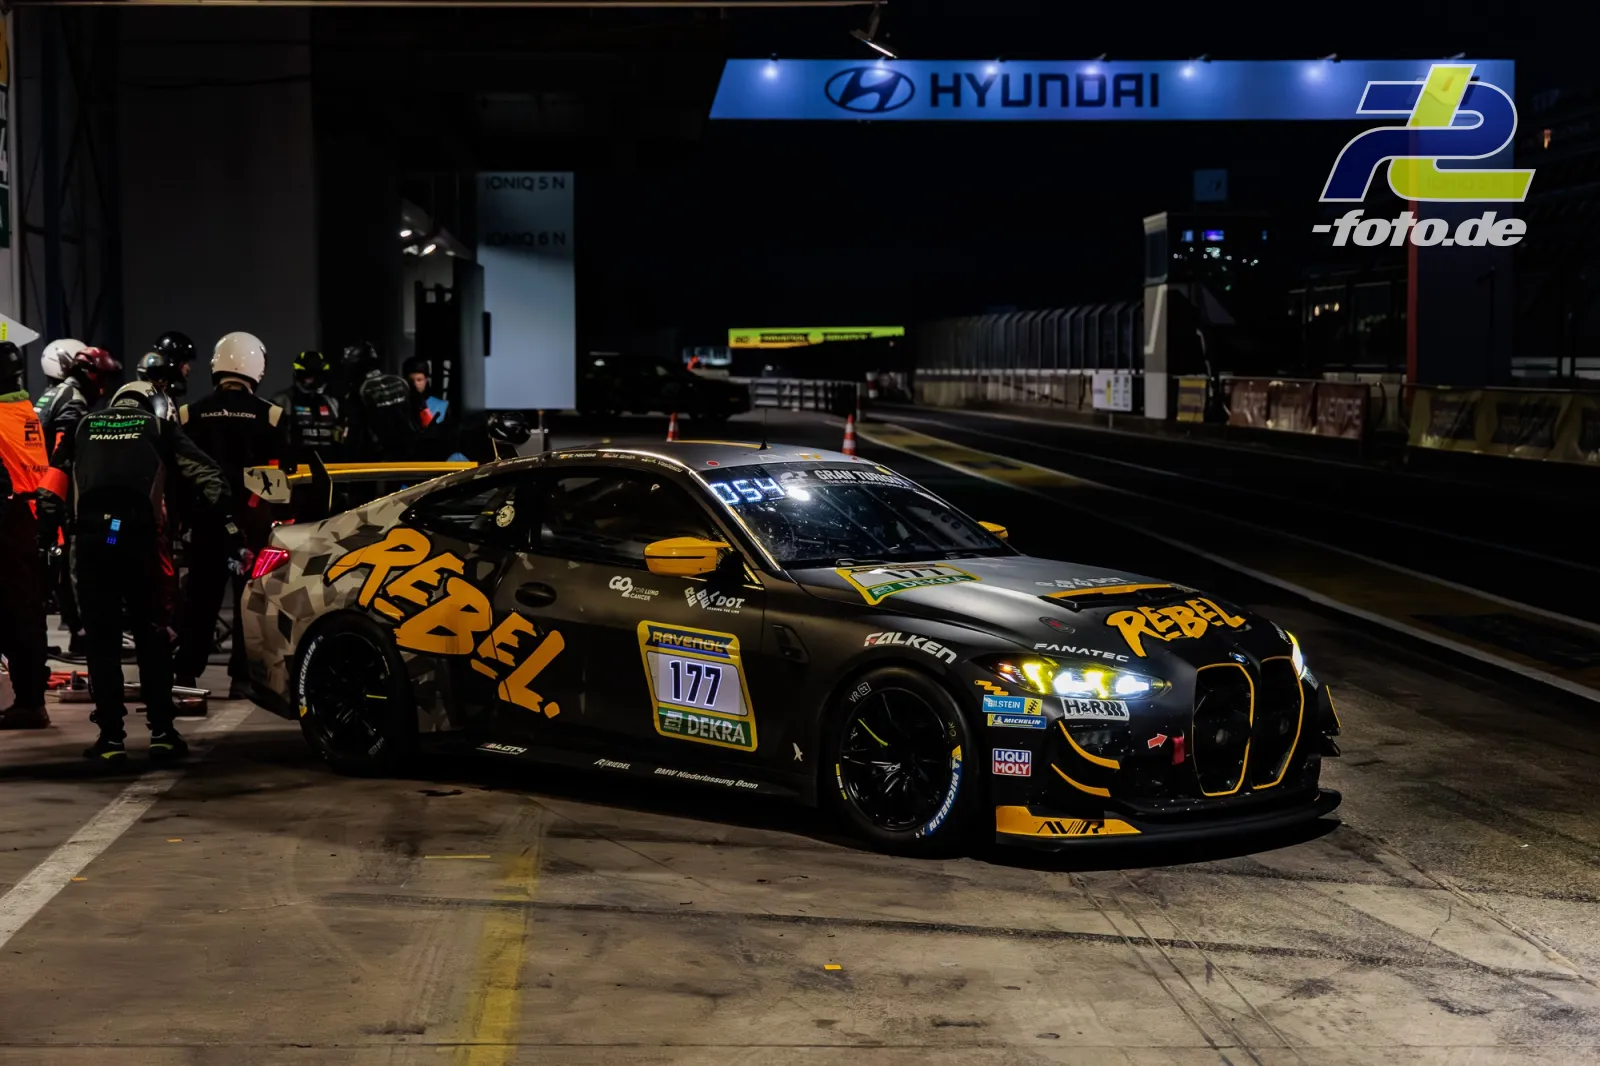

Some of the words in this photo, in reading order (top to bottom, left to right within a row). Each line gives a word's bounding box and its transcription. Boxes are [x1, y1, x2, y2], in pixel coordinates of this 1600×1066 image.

[931, 73, 1158, 107] HYUNDAI
[486, 176, 534, 191] IONIQ
[539, 176, 549, 190] 5
[553, 177, 565, 189] N
[539, 231, 549, 246] 6
[553, 231, 566, 246] N
[89, 432, 142, 441] FANATEC
[813, 469, 857, 480] GRAN
[899, 575, 968, 589] DEKRA
[1106, 597, 1246, 658] REBEL
[652, 631, 725, 653] RAVENOL
[864, 631, 958, 664] FALKEN
[1033, 642, 1130, 663] FANATEC
[669, 660, 722, 707] 177
[987, 699, 1021, 709] BILSTEIN
[1065, 701, 1104, 715] H&R
[687, 714, 746, 745] DEKRA
[1003, 718, 1041, 726] MICHELIN
[994, 750, 1030, 763] LIQUI
[994, 763, 1030, 775] MOLY
[654, 767, 678, 777] BMW
[676, 771, 735, 786] Niederlassung
[735, 779, 759, 790] Bonn
[928, 773, 960, 833] MICHELIN
